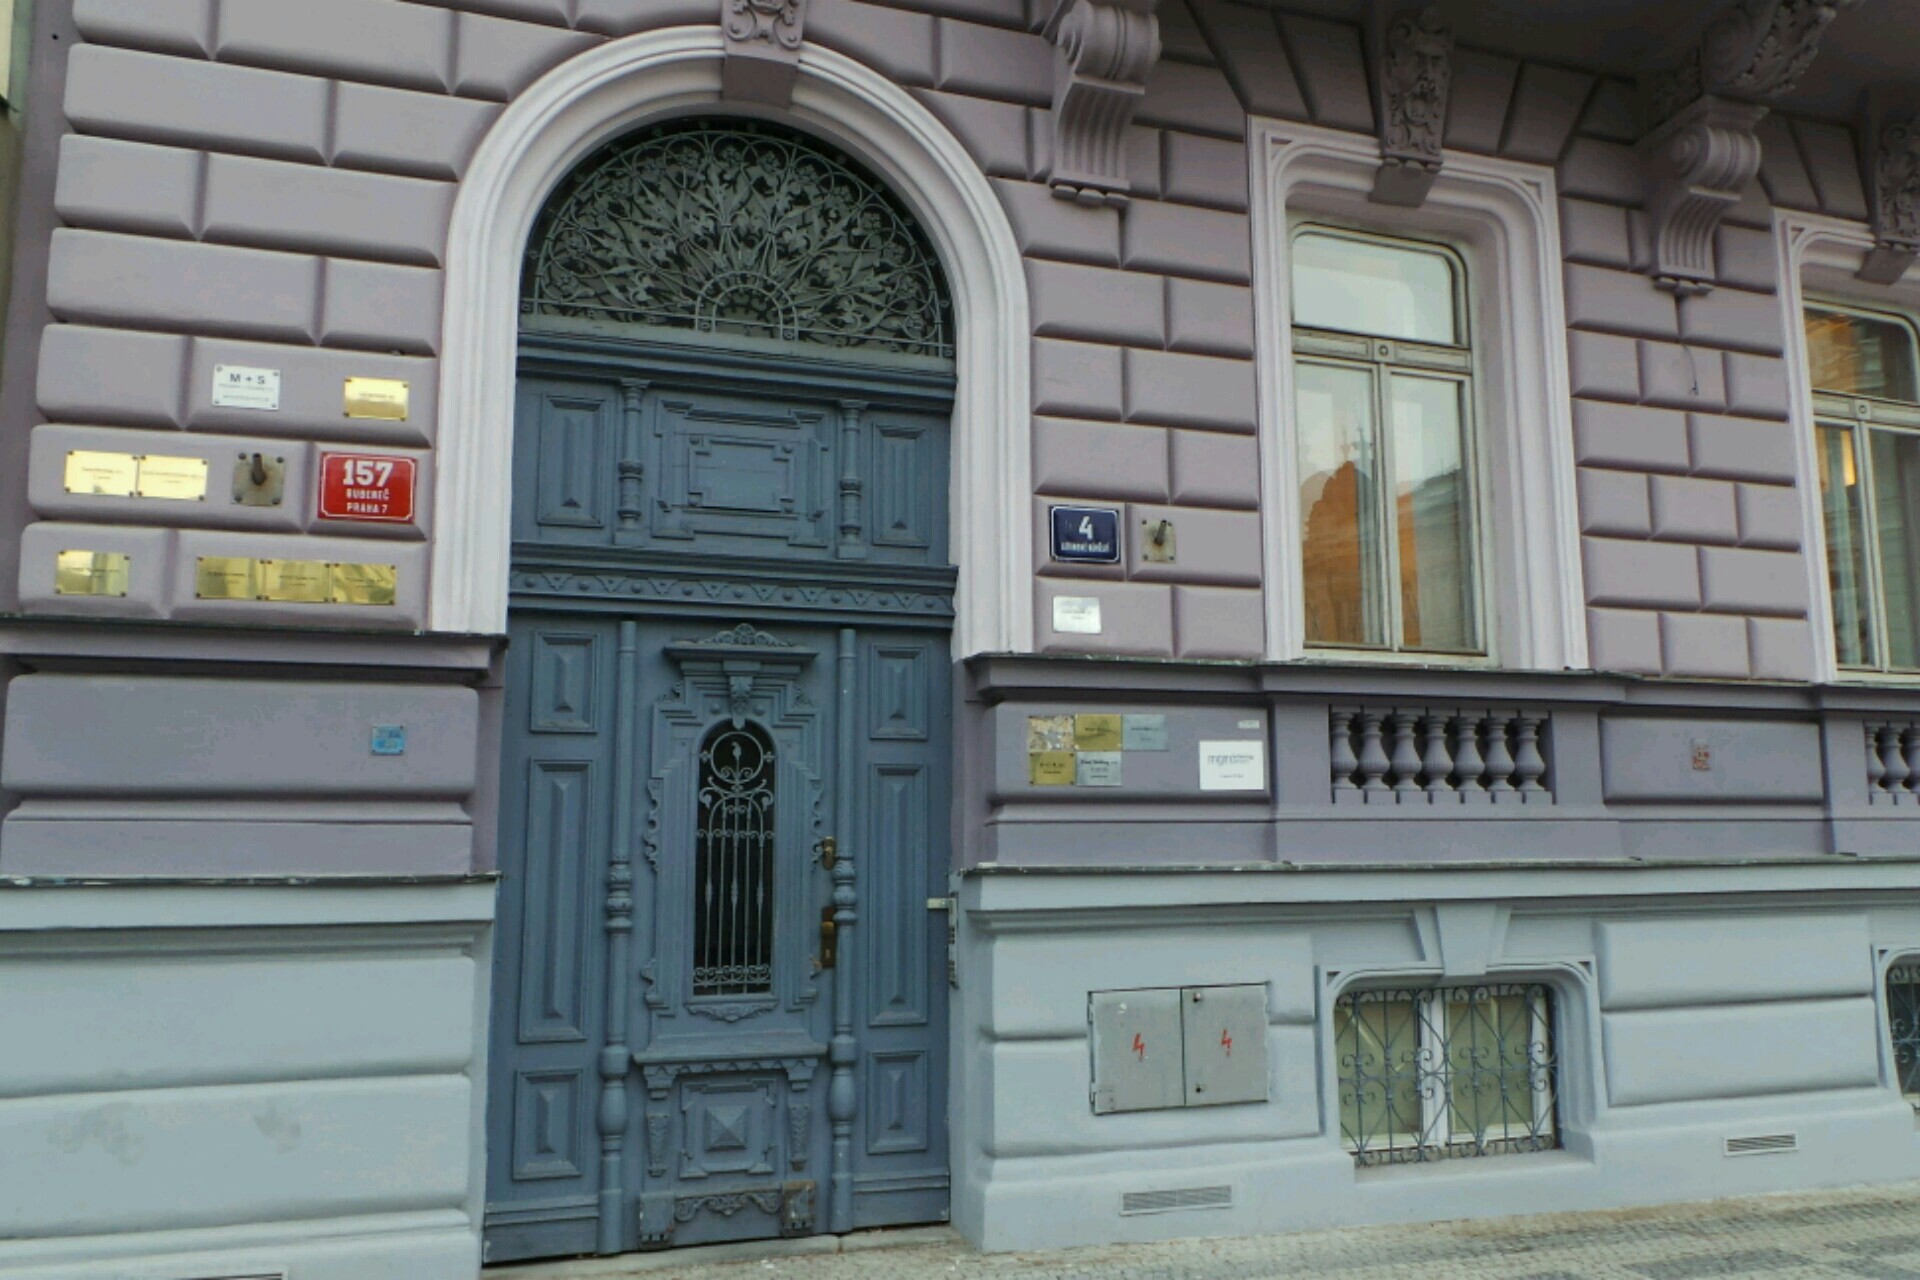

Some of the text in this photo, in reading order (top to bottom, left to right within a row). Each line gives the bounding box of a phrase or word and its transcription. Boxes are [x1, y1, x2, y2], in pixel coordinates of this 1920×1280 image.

[229, 373, 241, 383] M
[257, 375, 265, 385] S
[342, 459, 394, 487] 157
[346, 502, 388, 514] PRAHA 7
[1078, 515, 1094, 540] 4
